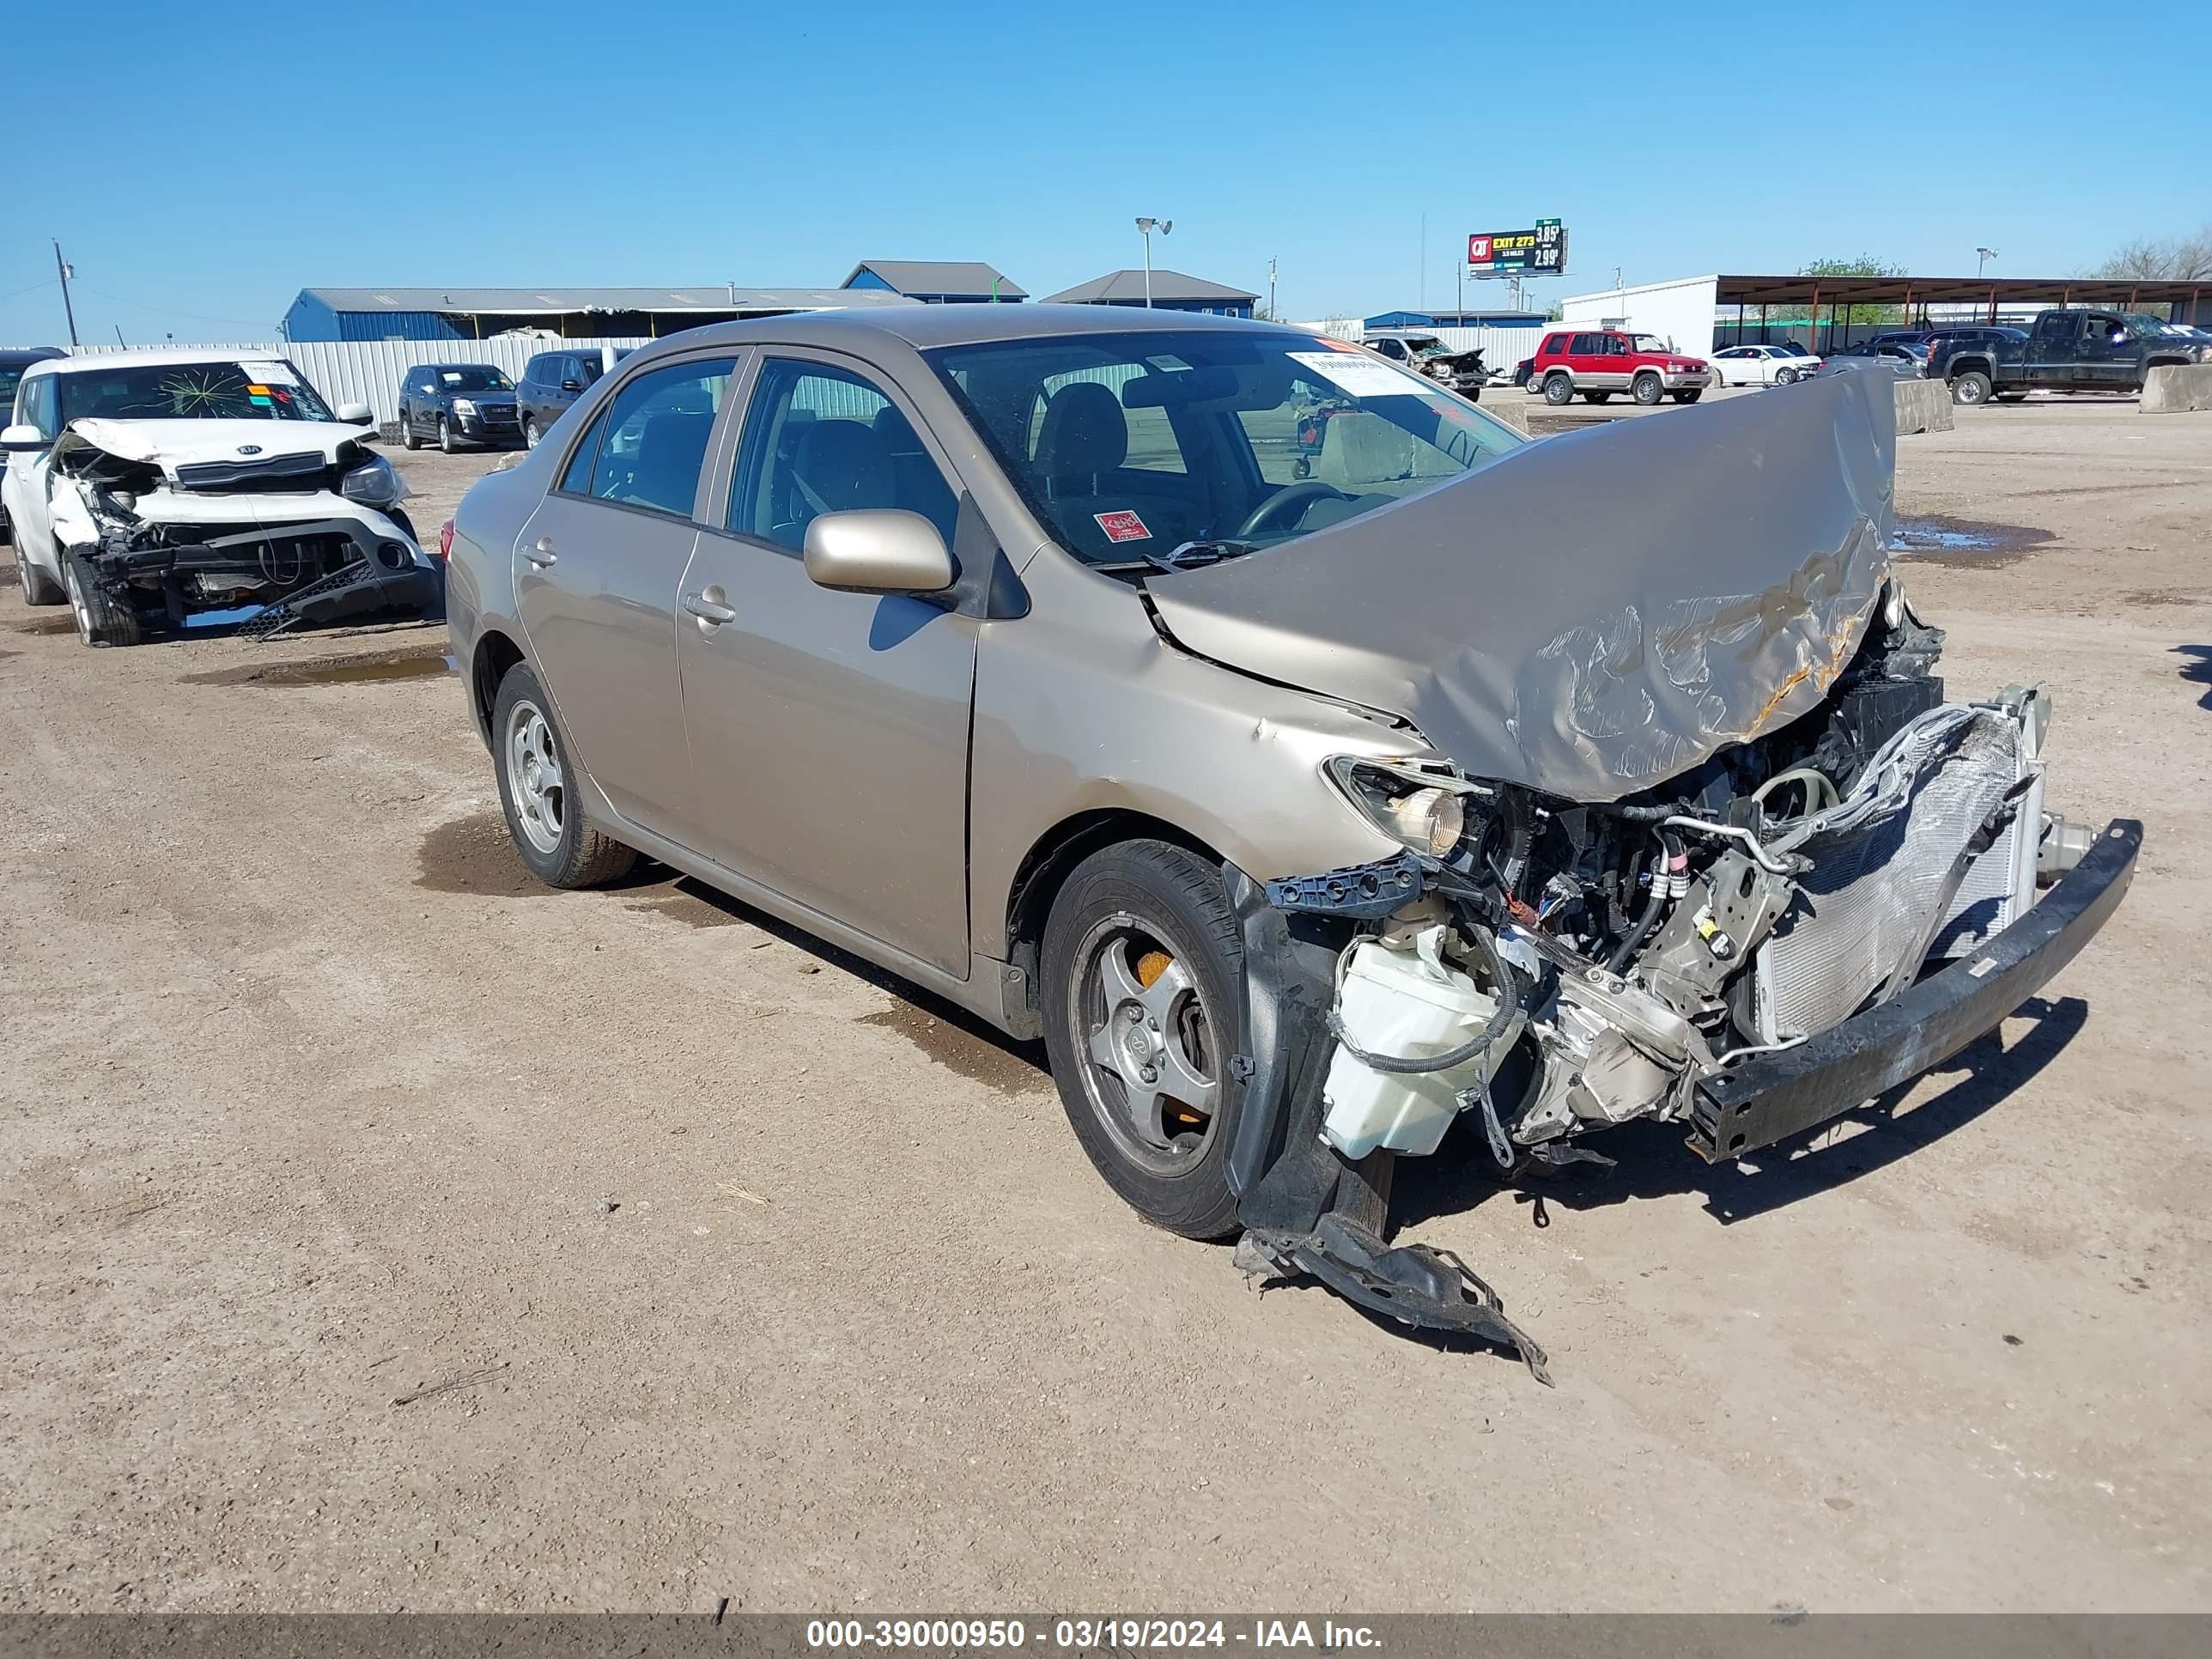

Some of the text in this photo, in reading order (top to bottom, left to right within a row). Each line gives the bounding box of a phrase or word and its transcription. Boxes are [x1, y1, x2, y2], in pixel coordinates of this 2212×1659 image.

[1472, 240, 1489, 258] QT
[1493, 237, 1516, 248] EXIT
[1516, 236, 1534, 247] 273
